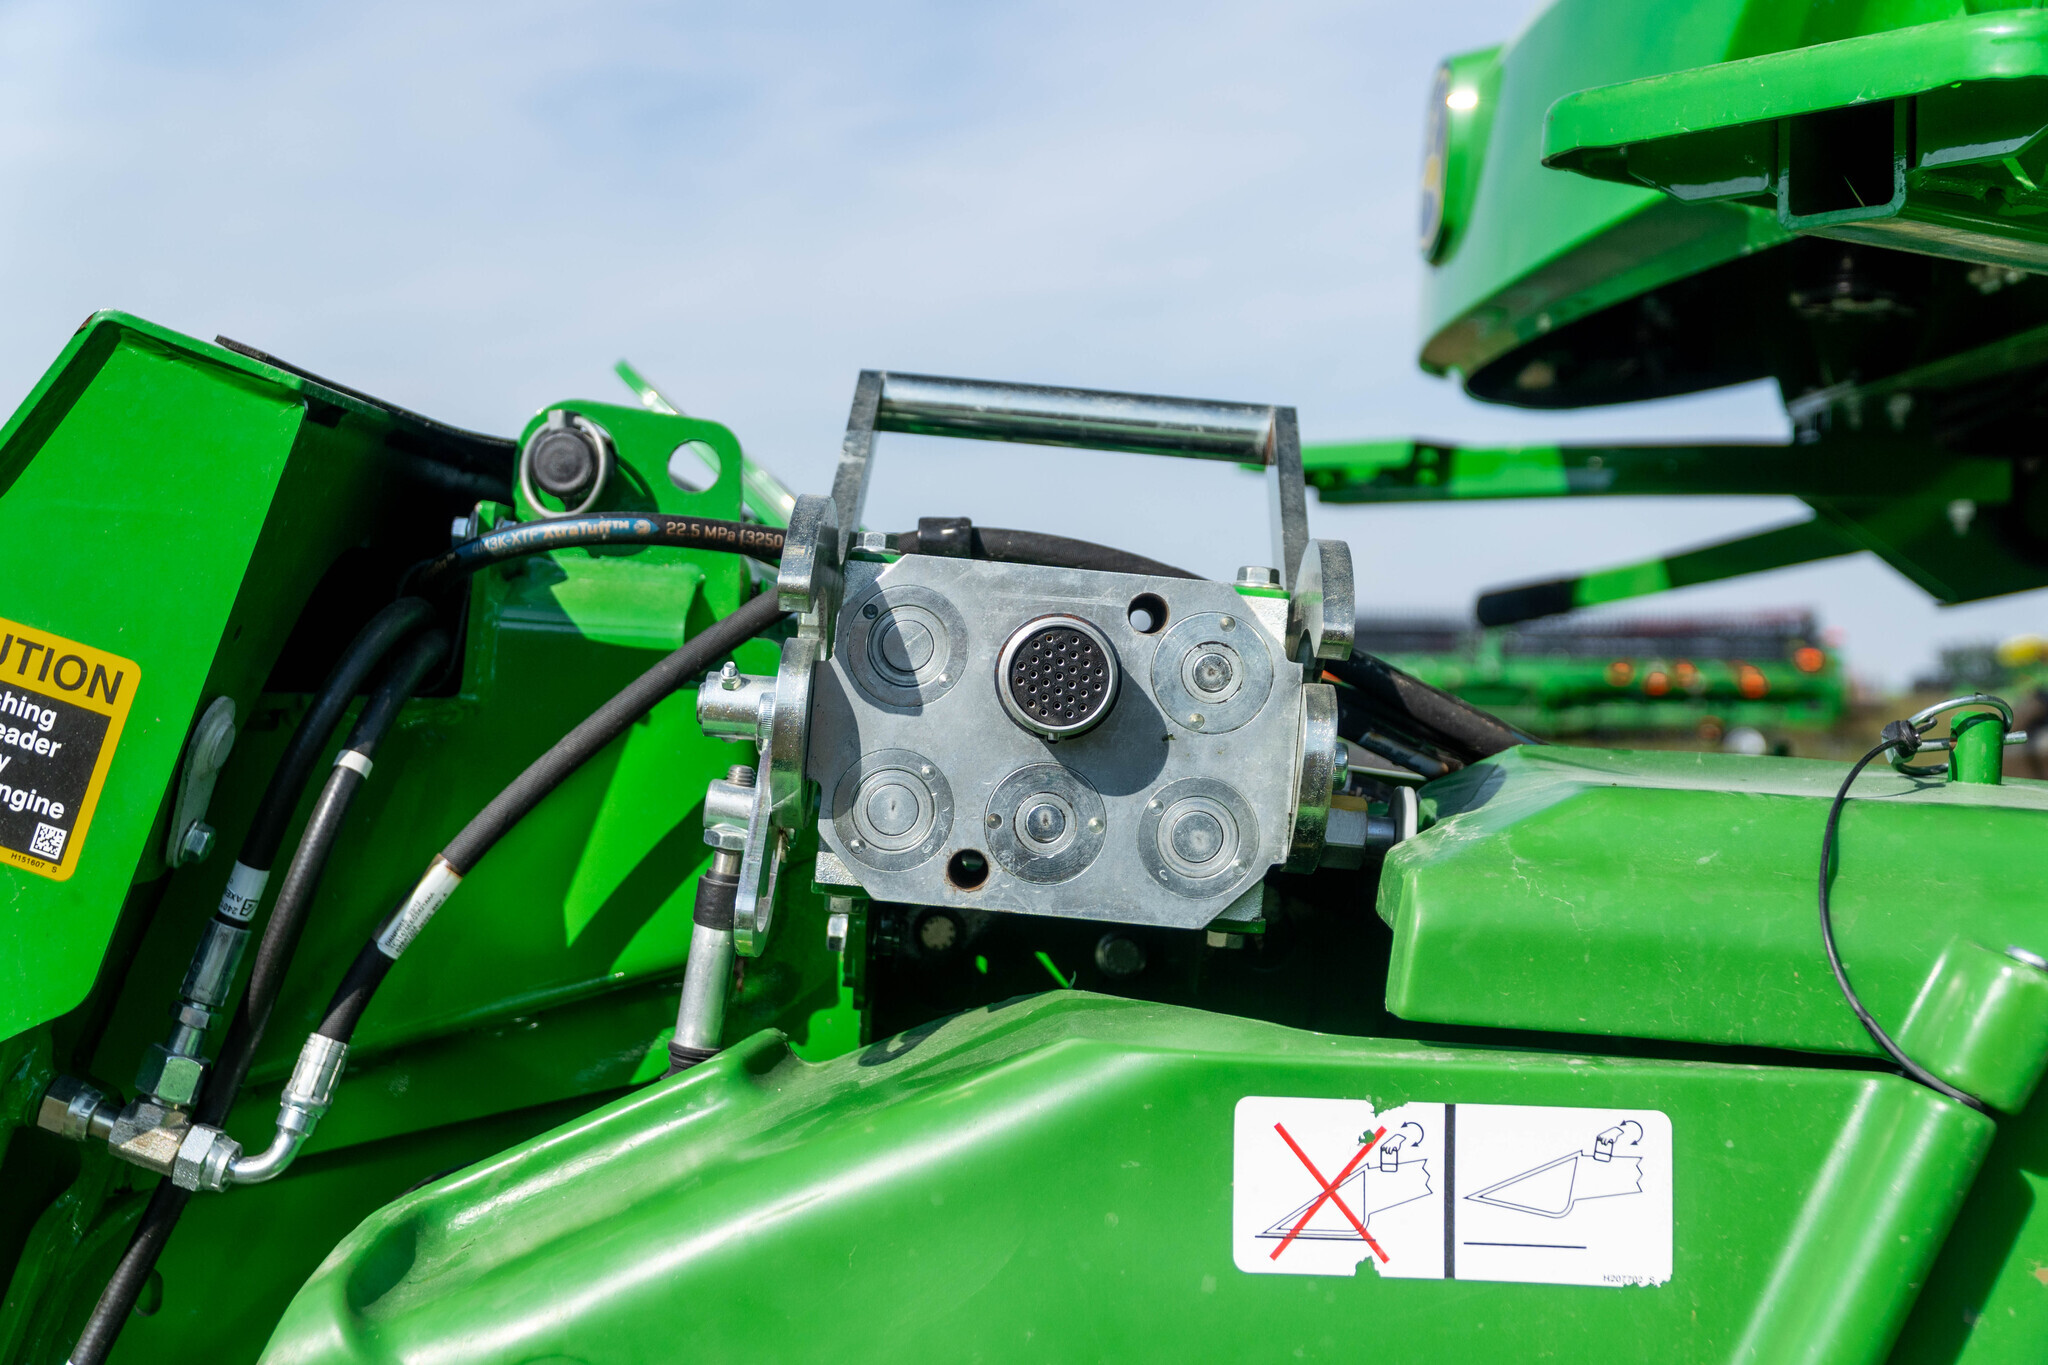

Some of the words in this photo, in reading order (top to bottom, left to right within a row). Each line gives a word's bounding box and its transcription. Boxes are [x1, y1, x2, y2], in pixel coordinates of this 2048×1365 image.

[666, 521, 700, 537] 22.5
[704, 525, 736, 542] MPa
[0, 691, 57, 732] hing
[11, 853, 45, 869] H151607
